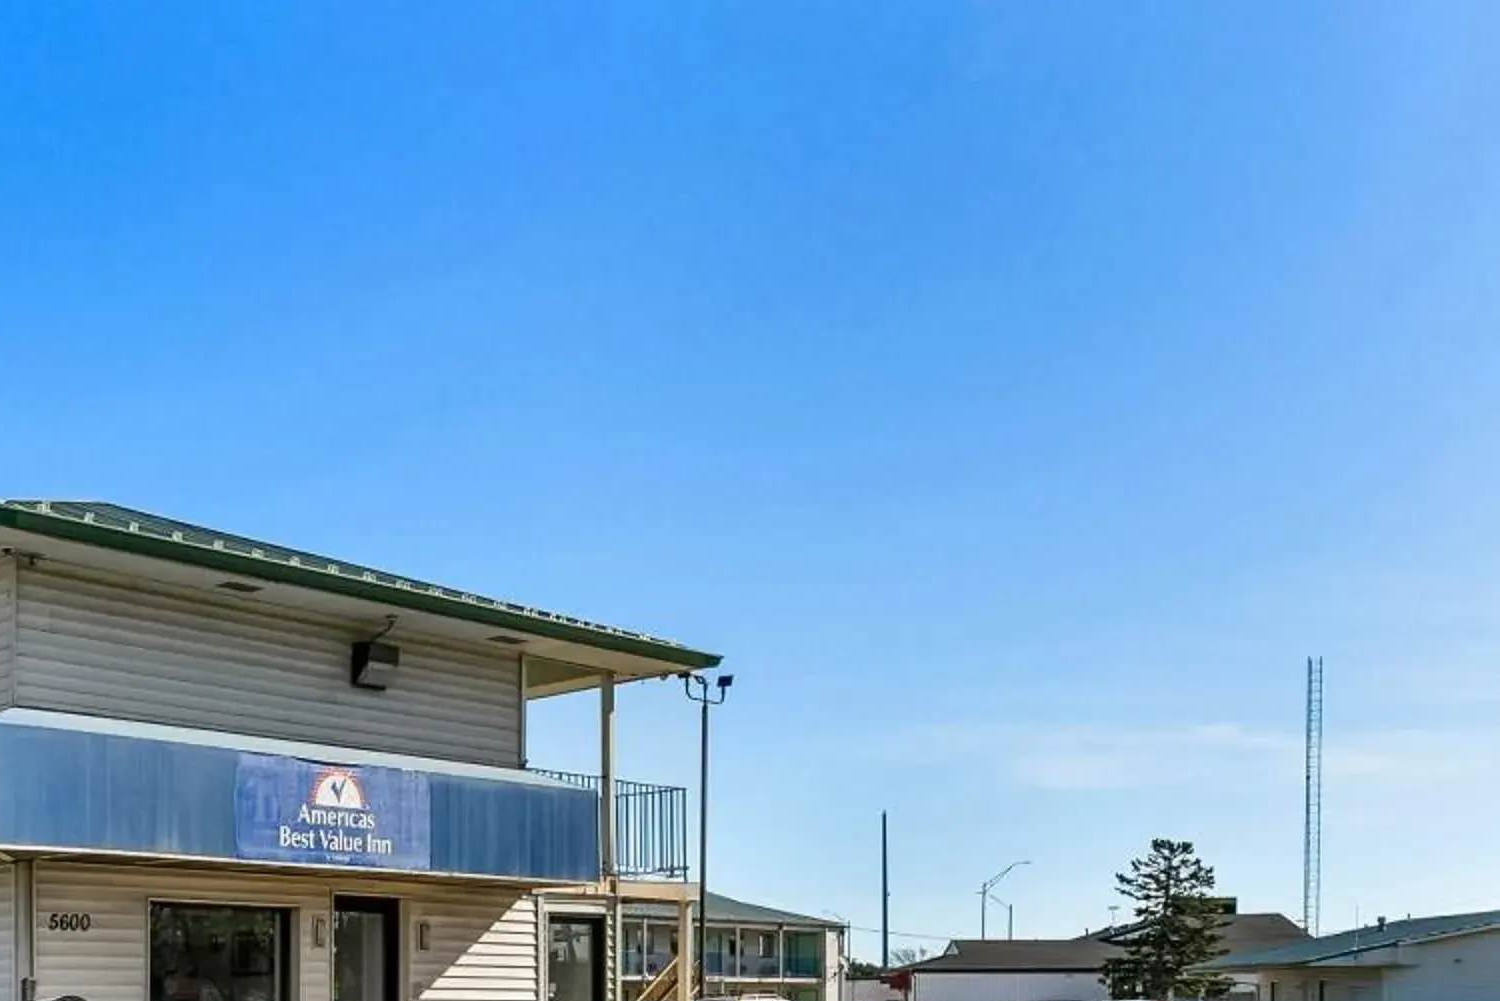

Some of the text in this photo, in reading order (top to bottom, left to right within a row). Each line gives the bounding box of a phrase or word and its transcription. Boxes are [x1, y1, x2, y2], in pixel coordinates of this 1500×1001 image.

[297, 803, 376, 829] Americas
[279, 825, 393, 855] Best Value Inn
[48, 913, 91, 931] 5600
